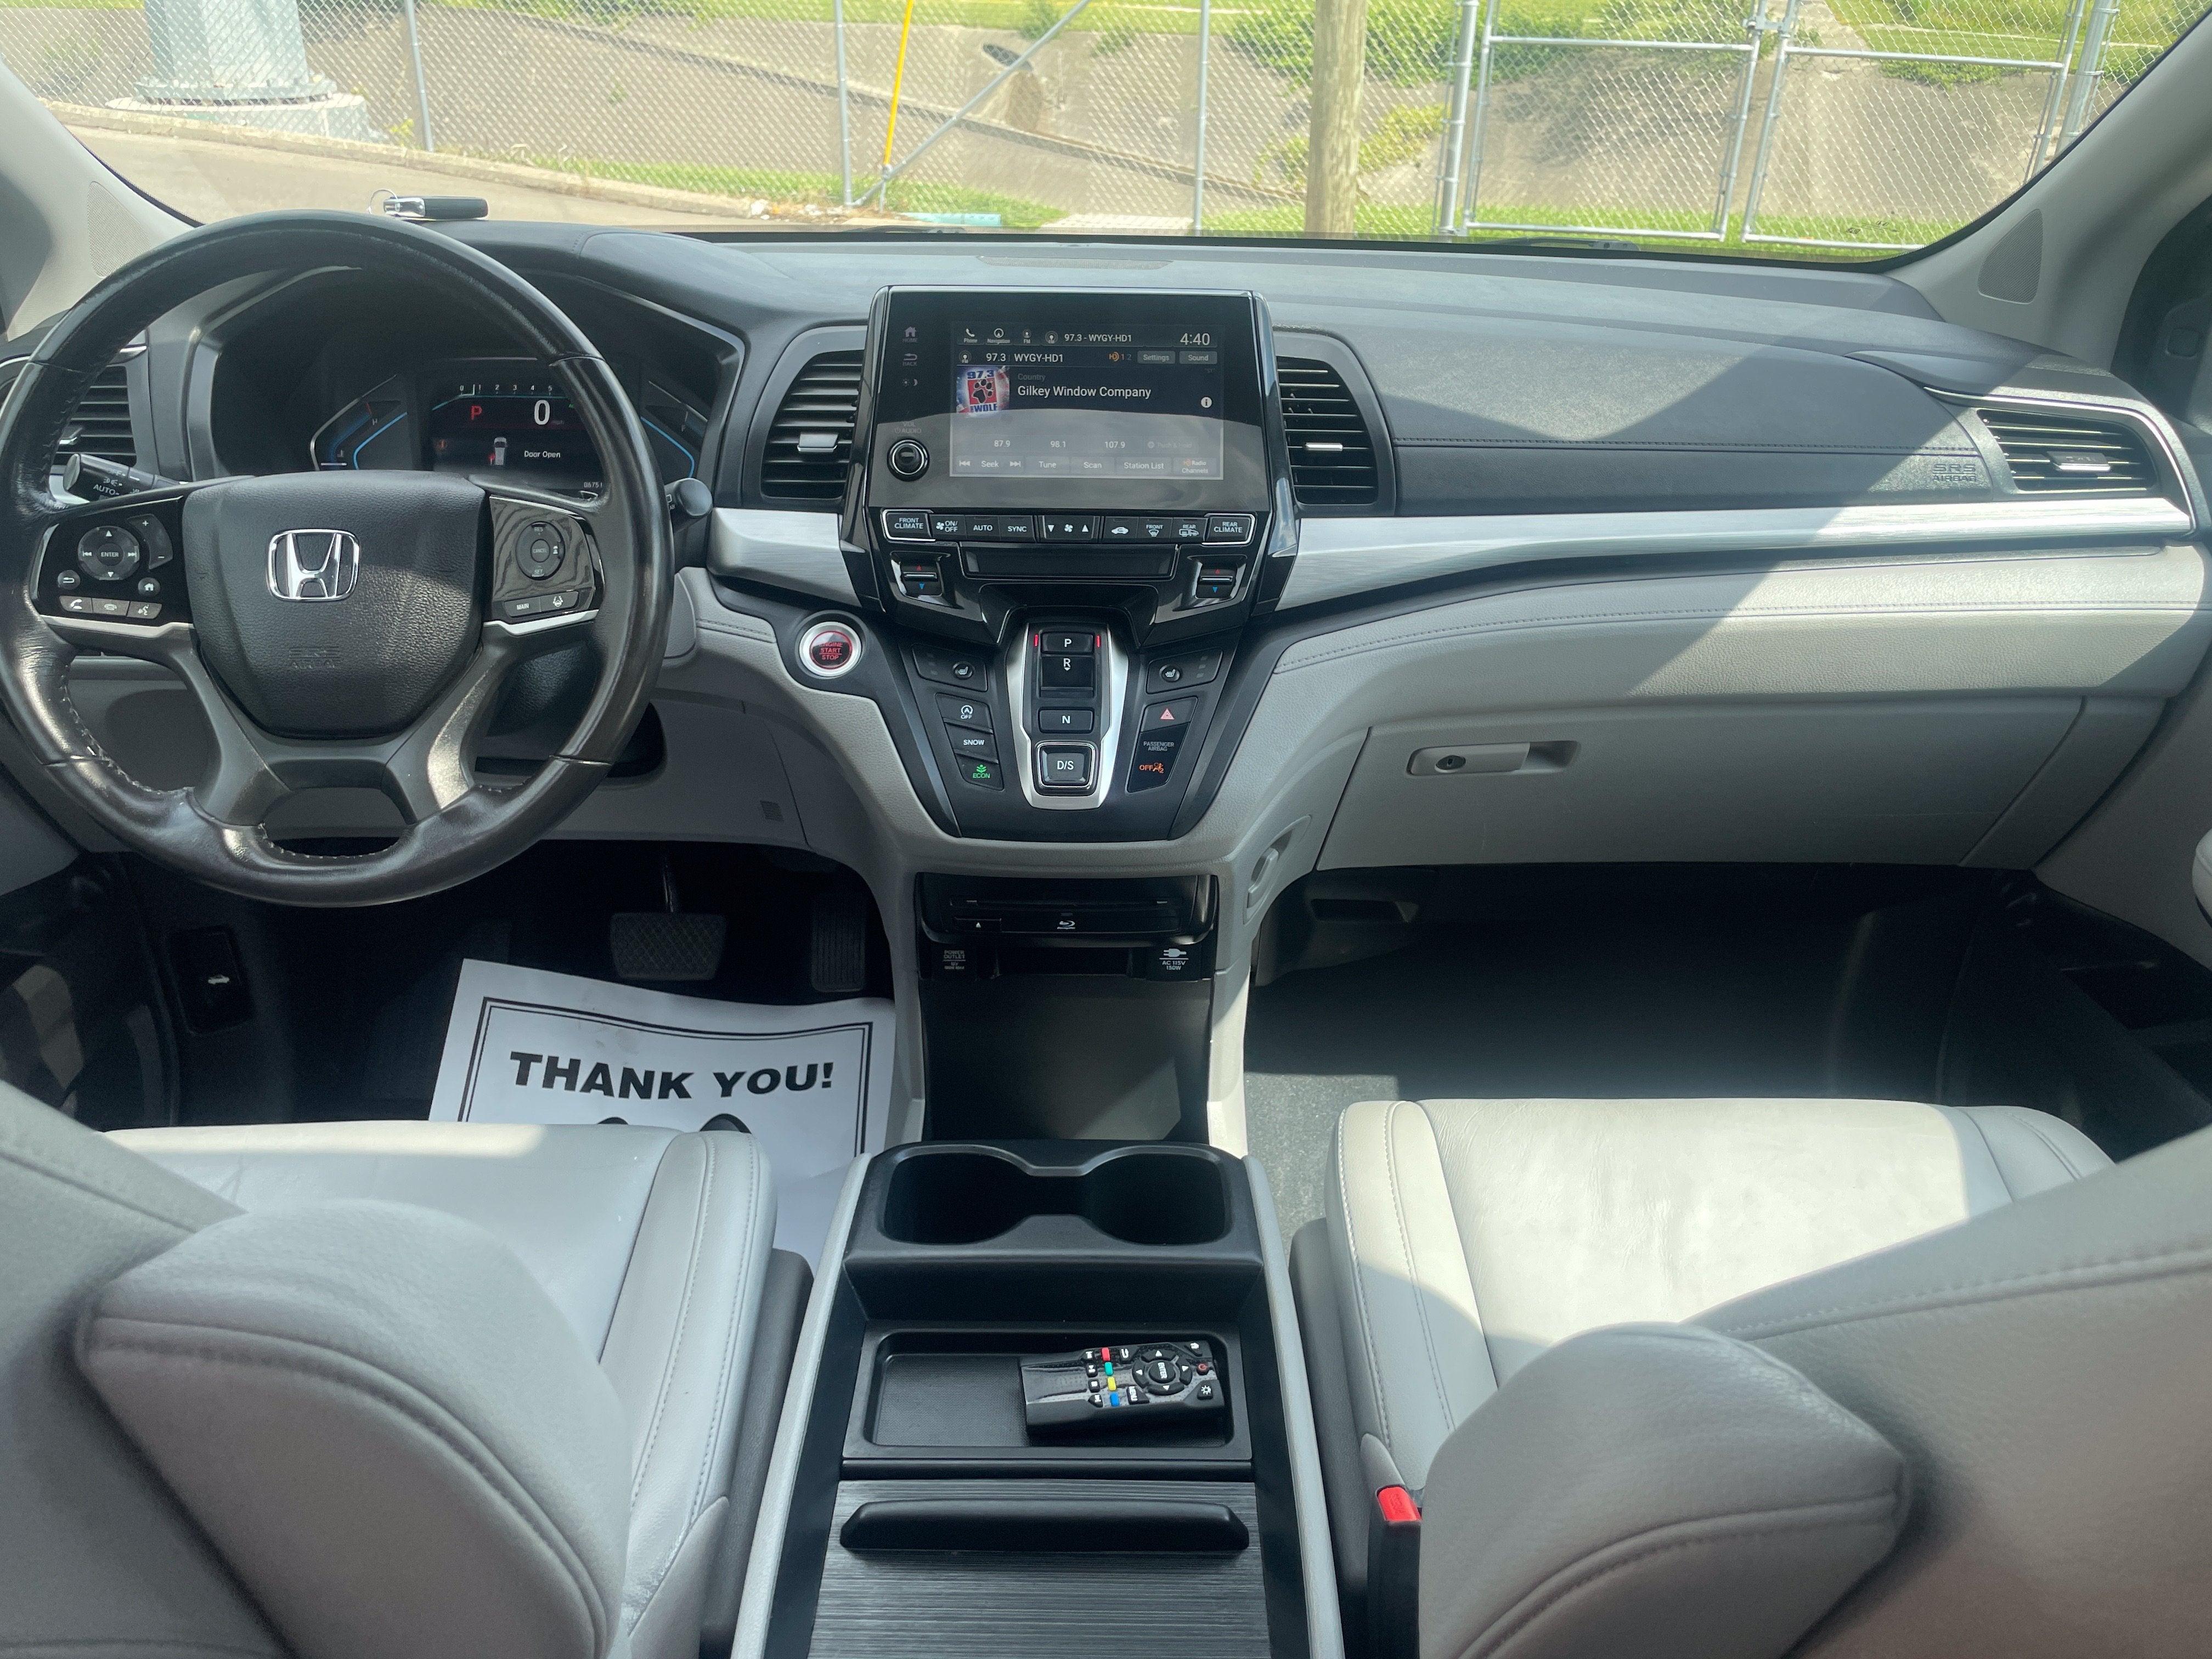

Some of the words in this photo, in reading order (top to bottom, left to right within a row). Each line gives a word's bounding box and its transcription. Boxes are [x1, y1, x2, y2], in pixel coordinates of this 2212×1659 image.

[1064, 334, 1082, 342] 97.3
[1180, 333, 1210, 345] 4:40
[986, 353, 1006, 362] 97.3
[1014, 353, 1063, 362] WYGY-HD1
[1018, 374, 1046, 382] Country
[1018, 386, 1051, 398] Gilkey
[1053, 386, 1096, 396] Window
[1099, 386, 1152, 399] Company
[470, 405, 483, 420] P
[534, 399, 550, 425] 0
[1934, 464, 1976, 472] SRS
[93, 484, 116, 495] AUTO
[1064, 638, 1072, 647] P
[1063, 658, 1071, 668] R
[1062, 715, 1070, 724] N
[1057, 760, 1074, 770] D/S
[510, 1051, 694, 1099] THANK
[713, 1062, 834, 1097] YOU!
[1158, 1362, 1167, 1379] ENTER
[1129, 1386, 1138, 1402] MENU
